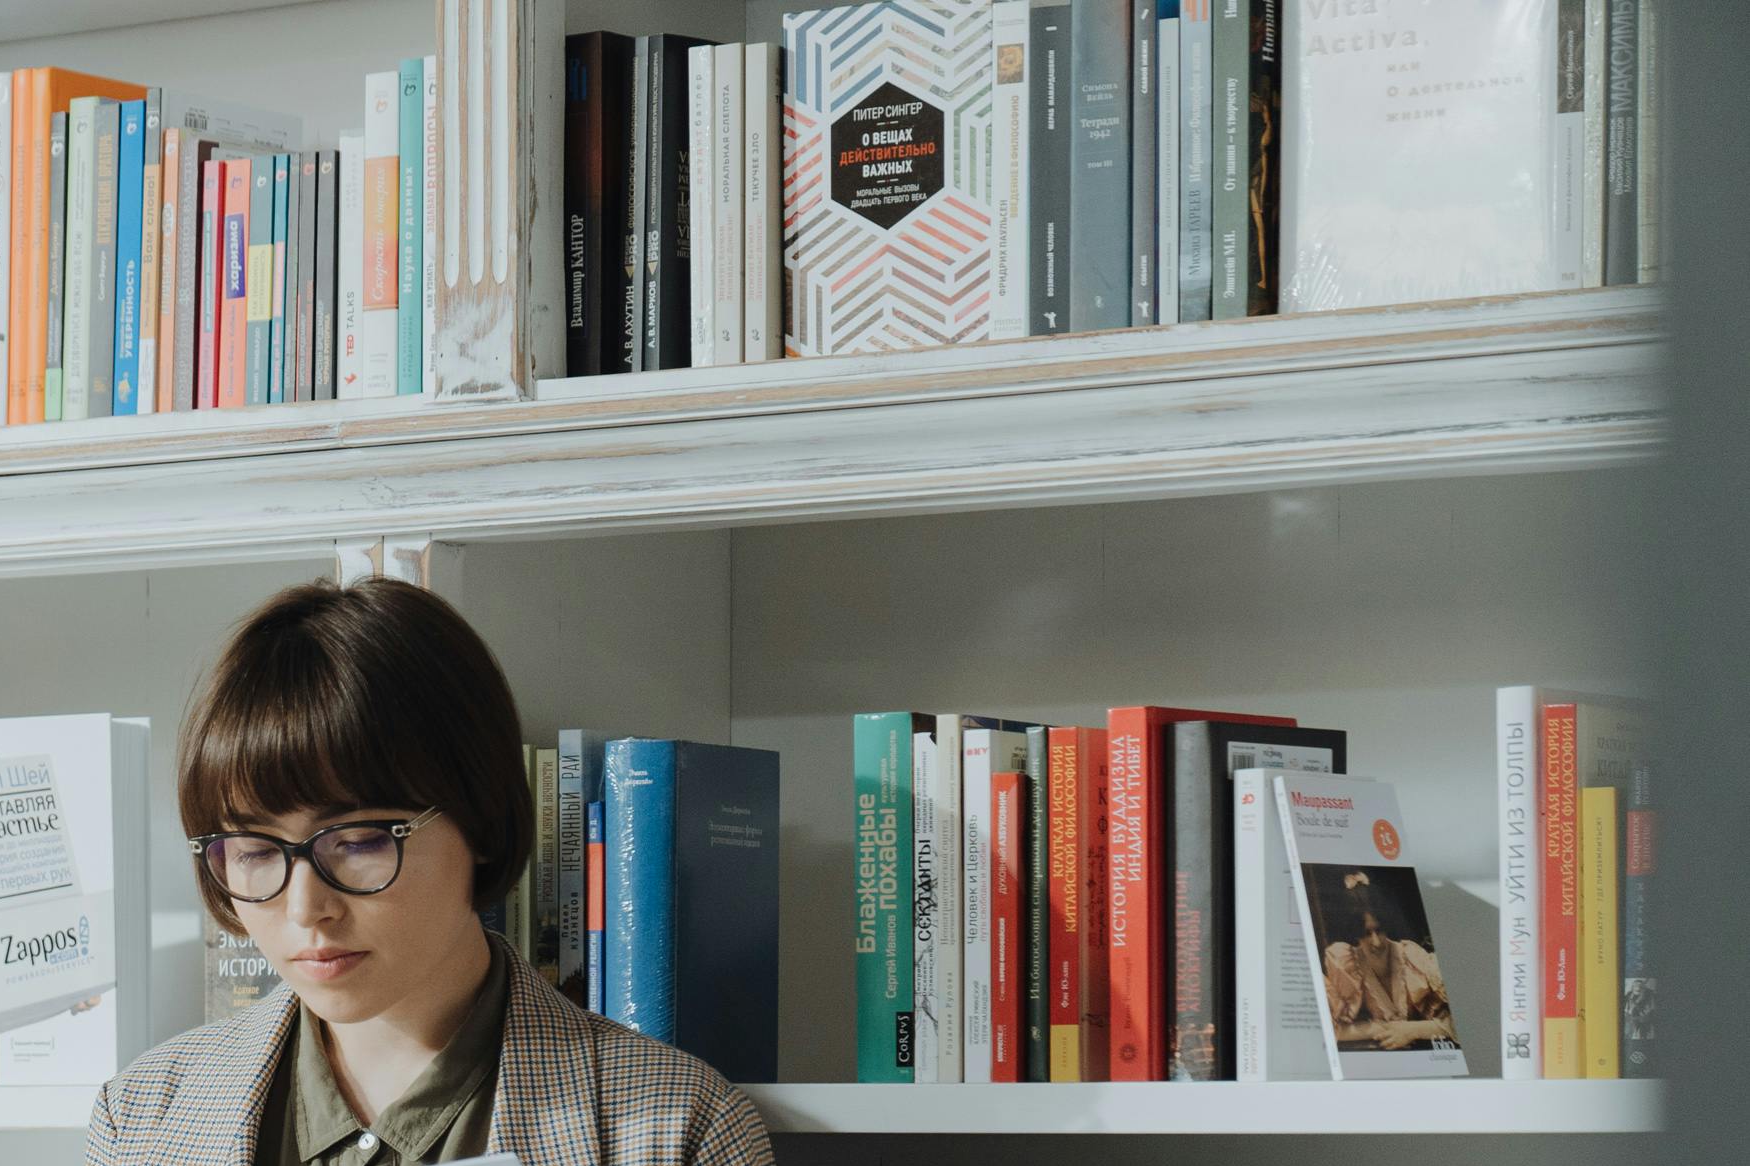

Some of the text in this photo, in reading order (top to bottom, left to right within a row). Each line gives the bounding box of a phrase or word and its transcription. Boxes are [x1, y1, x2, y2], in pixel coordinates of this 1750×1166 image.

[1306, 29, 1430, 56] Activa.
[853, 102, 923, 122] ПИТЕР СИНГЕР
[1080, 116, 1121, 129] Тетради
[1089, 128, 1112, 140] 1942
[1225, 78, 1238, 126] творчеству
[721, 136, 731, 203] МОРАЛЬНАЯ
[839, 141, 936, 167] ДЕЙСТВИТЕЛЬНО
[862, 128, 913, 146] О ВЕЩАХ
[862, 160, 914, 178] ВАЖНЫХ
[142, 174, 156, 264] Вам слово!
[403, 166, 415, 226] данных
[851, 191, 928, 208] ДВАДЦАТЬ ПЕРВОГО ВЕКА
[856, 183, 920, 198] МОРАЛЬНЫЕ ВЫЗОВЫ
[228, 220, 243, 290] харизма
[369, 229, 390, 301] Скорость
[401, 245, 414, 294] Наука
[425, 262, 436, 288] УЗНАТЬ
[570, 214, 586, 328] Владимир КАНТОР
[997, 200, 1009, 297] ФРИДРИХ ПАУЛЬСЕН
[126, 259, 137, 359] УВЕРЕННОСТЬ
[345, 290, 355, 329] TALKS
[624, 285, 636, 363] А. В. АХУТИН
[7, 763, 50, 788] Шей
[1126, 734, 1143, 882] ИНДИЯ И ТИБЕТ
[1290, 791, 1354, 812] Maupassant
[1547, 718, 1561, 858] КРАТКАЯ ИСТОРИЯ
[558, 754, 581, 872] НЕЧАЯННЫЙ РАЙ
[997, 790, 1008, 847] АЗБУКОВНИК
[1051, 745, 1065, 878] КРАТКАЯ ИСТОРИЯ
[1061, 743, 1077, 933] КИТАЙСКОЙ ФИЛОСОФИИ
[1109, 735, 1127, 948] ИСТОРИЯ БУДДИЗМА
[1559, 717, 1575, 917] КИТАЙСКОЙ ФИЛОСОФИИ
[1, 873, 48, 891] первых
[50, 867, 73, 885] рук
[19, 845, 66, 863] создания
[855, 794, 878, 954] Блаженные
[964, 814, 981, 945] Человек и Церковь
[1504, 721, 1530, 1022] Янгми Мун УЙТИ ИЗ ТОЛПЫ
[0, 926, 79, 967] Zappos
[884, 914, 898, 998] Сергей Иванов
[1175, 871, 1190, 1013] ВЕТХОЗАВЕТНЫЕ
[1187, 909, 1202, 1013] АПОКРИФЫ
